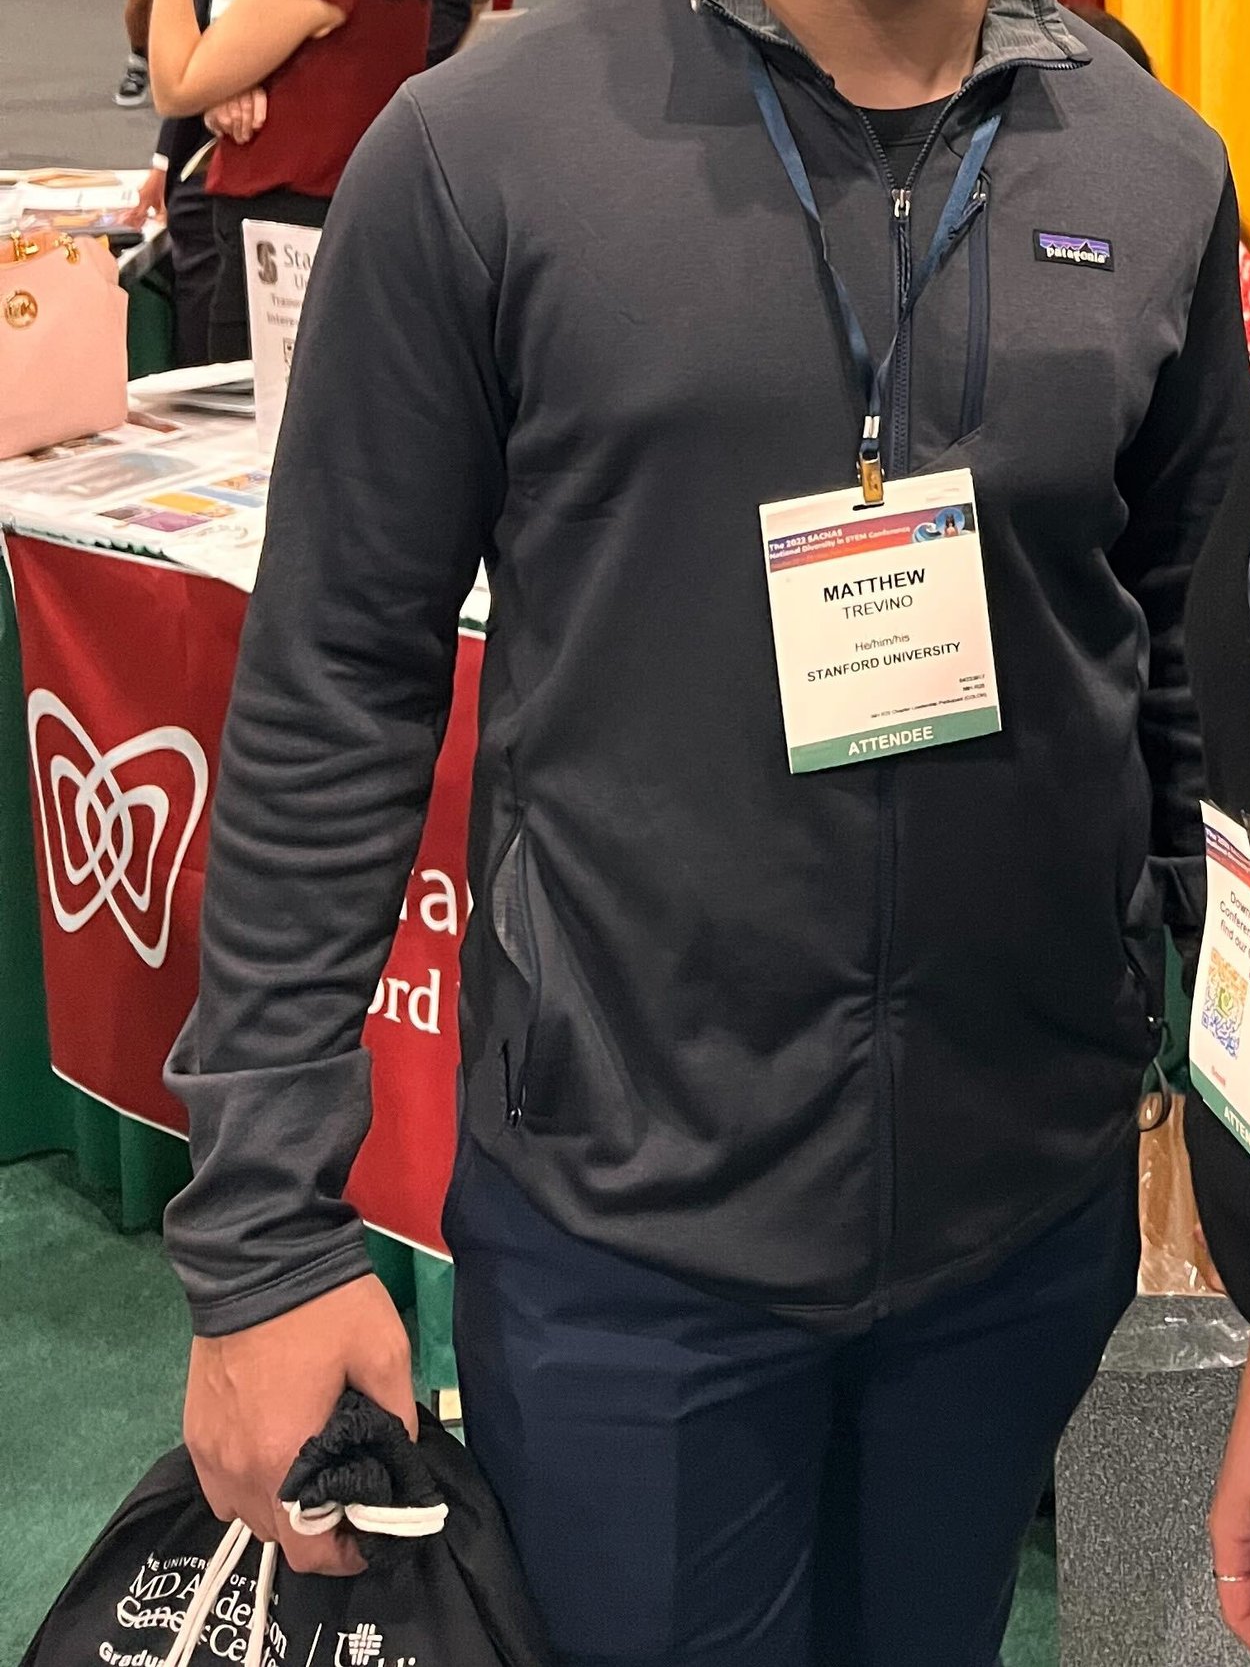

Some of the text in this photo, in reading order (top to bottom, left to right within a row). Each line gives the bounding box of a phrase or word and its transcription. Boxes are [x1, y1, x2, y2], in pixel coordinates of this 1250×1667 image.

[1046, 246, 1105, 264] patagonia
[823, 568, 926, 602] MATTHEW
[842, 595, 913, 620] TREVINO
[855, 634, 910, 652] He/him/his
[807, 642, 961, 682] STANFORD UNIVERSITY
[849, 725, 934, 757] ATTENDEE
[1220, 919, 1234, 941] find
[1234, 937, 1248, 953] our
[129, 1565, 181, 1601] MD
[230, 1574, 247, 1587] OF
[99, 1645, 163, 1667] Gradu
